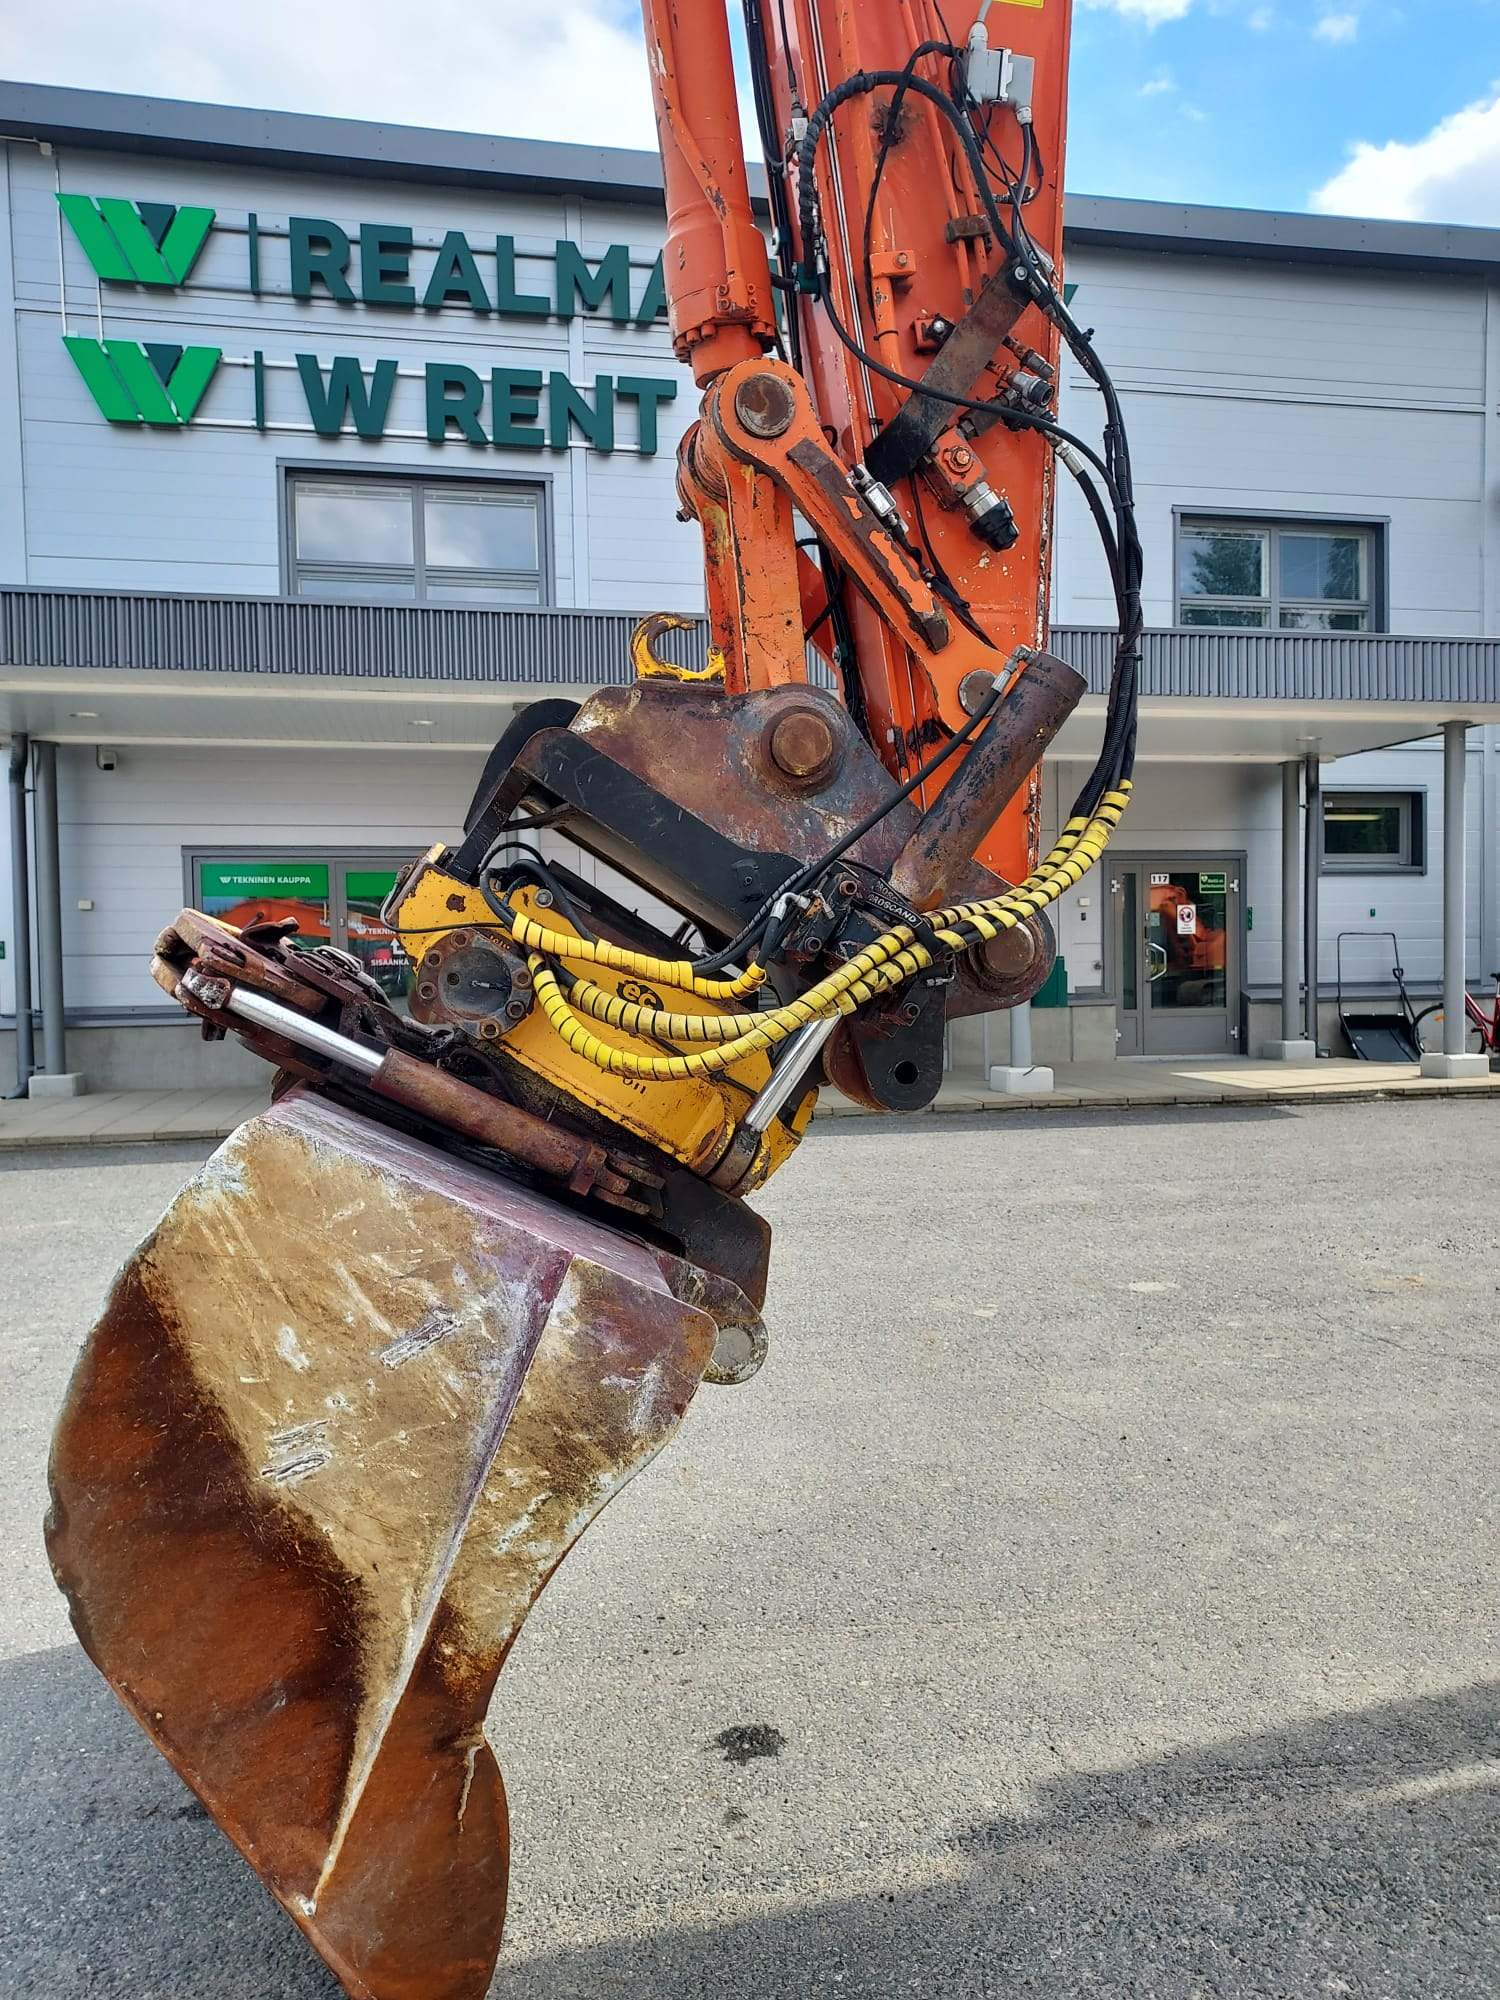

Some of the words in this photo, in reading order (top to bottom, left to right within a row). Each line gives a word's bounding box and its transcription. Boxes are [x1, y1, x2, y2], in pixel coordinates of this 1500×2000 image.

[295, 353, 398, 440] W
[425, 362, 677, 456] RENT
[232, 876, 275, 884] TEKNINEN
[277, 876, 311, 884] KAUPPA
[1152, 875, 1168, 883] 117
